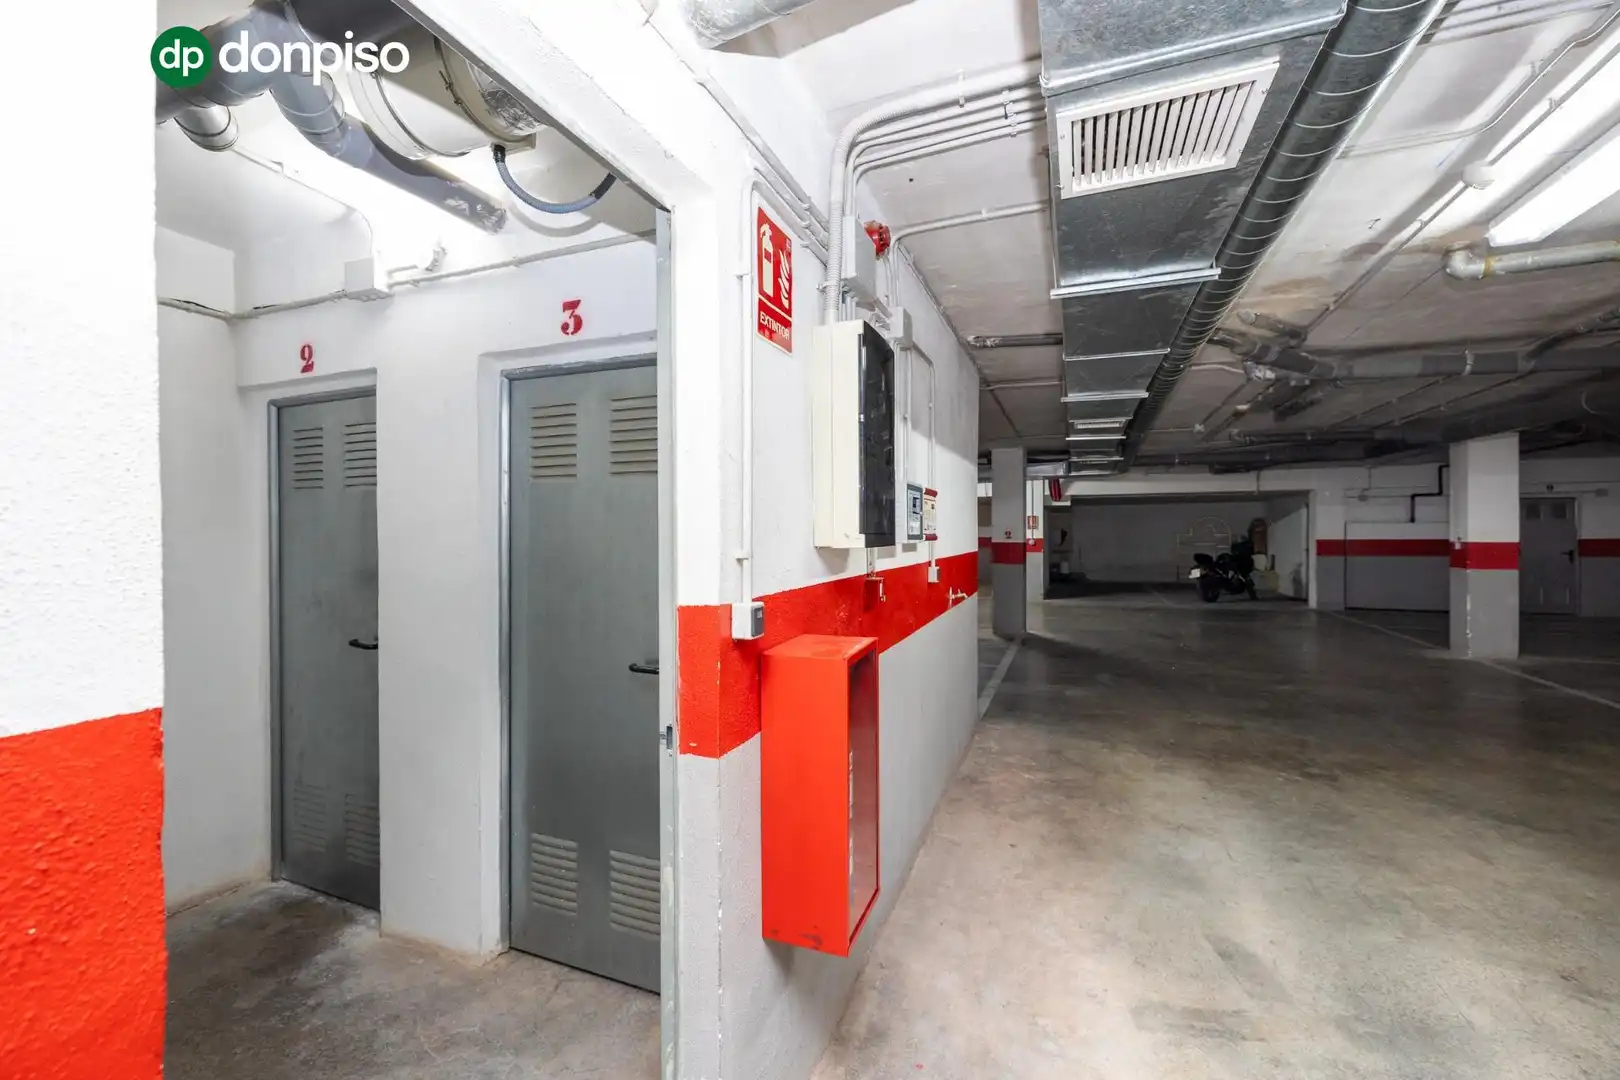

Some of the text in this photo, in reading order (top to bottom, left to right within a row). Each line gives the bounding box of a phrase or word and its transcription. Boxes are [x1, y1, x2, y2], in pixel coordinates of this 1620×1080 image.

[560, 298, 583, 336] 3
[760, 310, 790, 341] EXTINTOR
[300, 343, 315, 374] 2
